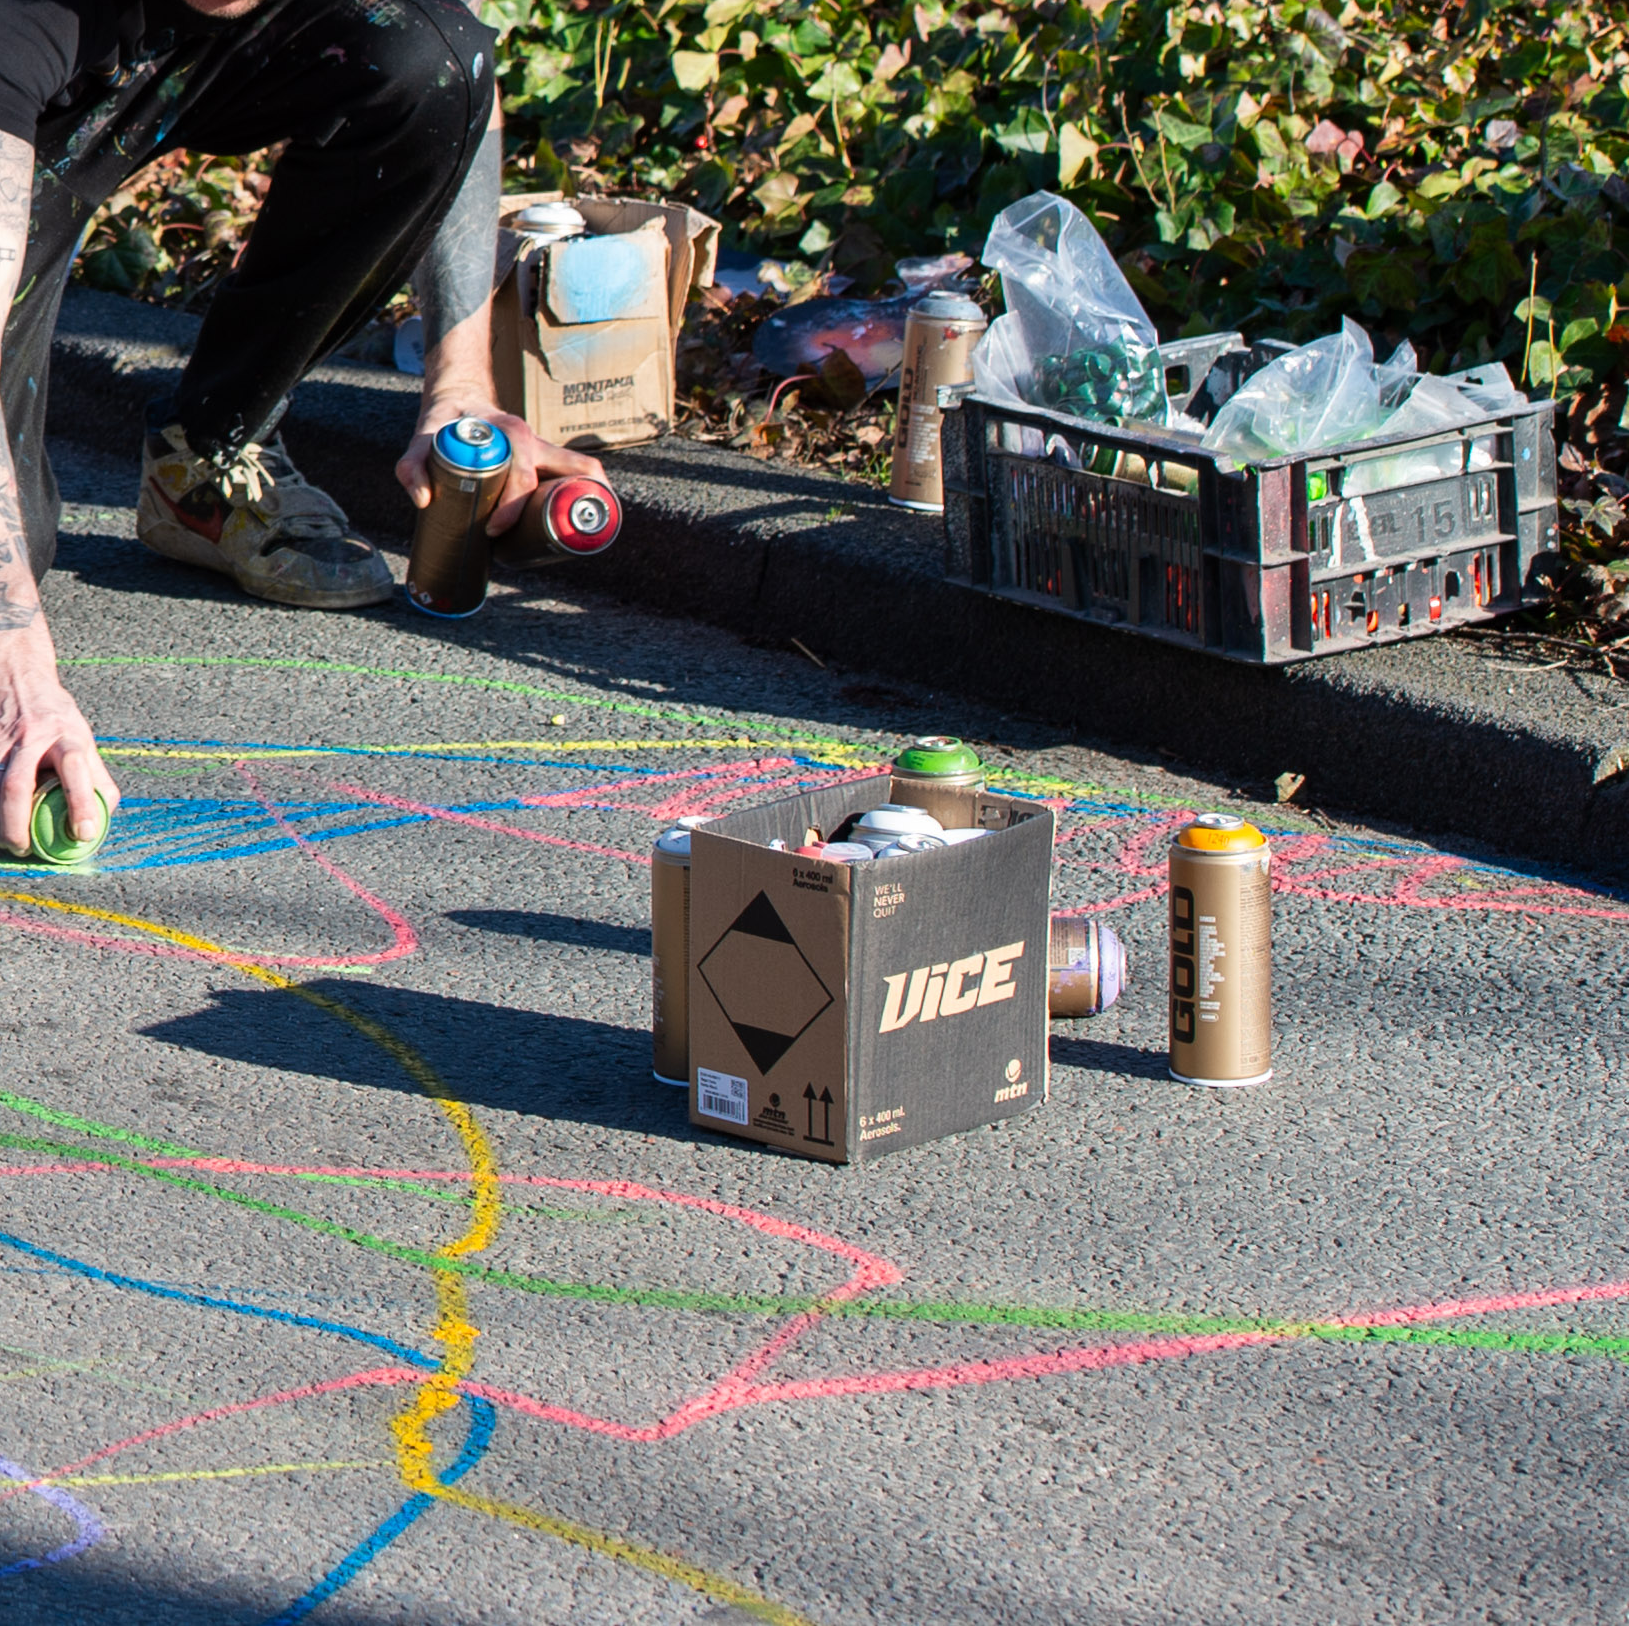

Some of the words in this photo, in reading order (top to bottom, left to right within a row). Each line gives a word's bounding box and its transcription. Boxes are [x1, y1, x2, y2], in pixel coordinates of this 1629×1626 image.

[563, 375, 634, 395] MONTANA
[563, 392, 603, 406] CANS
[898, 367, 914, 449] GOLD
[806, 869, 821, 881] 400
[792, 877, 829, 893] Aerosols
[874, 882, 903, 895] WE'LL
[873, 892, 906, 908] NEVER
[873, 905, 897, 919] QUIT
[1172, 885, 1196, 1044] GOLD
[995, 1081, 1028, 1103] mtn
[859, 1115, 867, 1128] 6
[868, 1117, 875, 1126] x
[876, 1109, 892, 1123] 400
